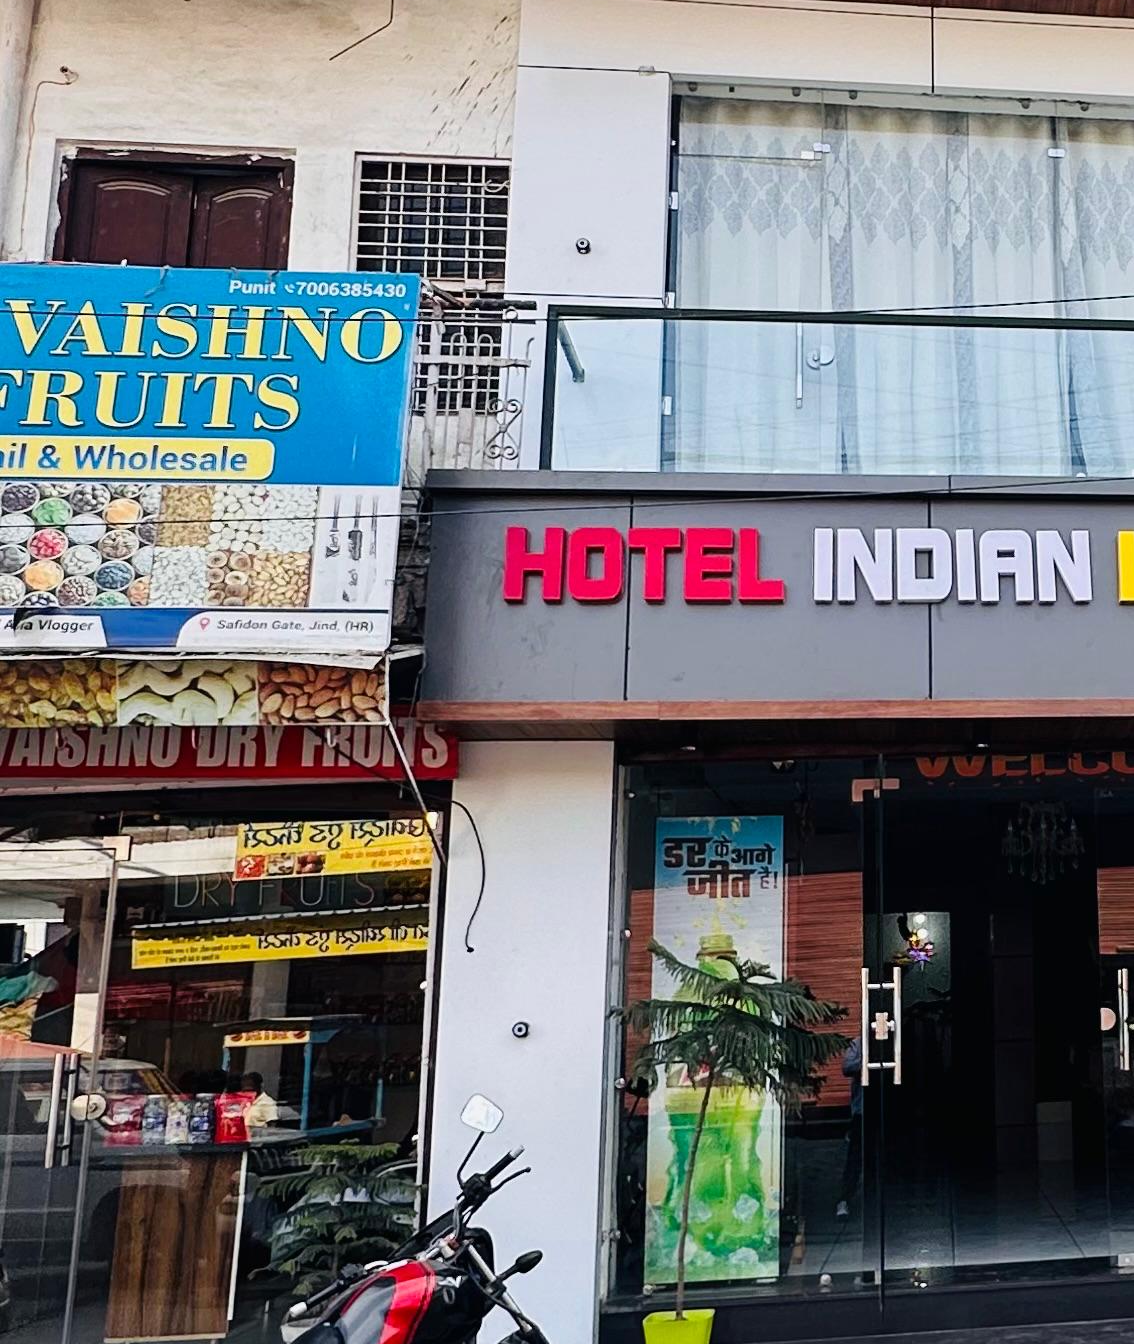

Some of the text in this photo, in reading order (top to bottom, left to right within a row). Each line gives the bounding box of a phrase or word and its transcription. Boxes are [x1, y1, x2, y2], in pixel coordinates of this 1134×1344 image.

[228, 279, 407, 298] Punit 7006385430
[4, 299, 404, 364] VAISHNO
[37, 444, 61, 471] &
[74, 444, 248, 472] Wholesale
[502, 525, 786, 605] HOTEL
[812, 526, 1094, 606] INDIAN
[38, 619, 95, 634] Vlogger
[216, 619, 268, 631] Safidon
[345, 621, 374, 633] (HR)
[196, 725, 284, 768] DRY
[712, 834, 733, 859] के
[731, 842, 777, 866] आगे
[682, 859, 758, 899] जीत
